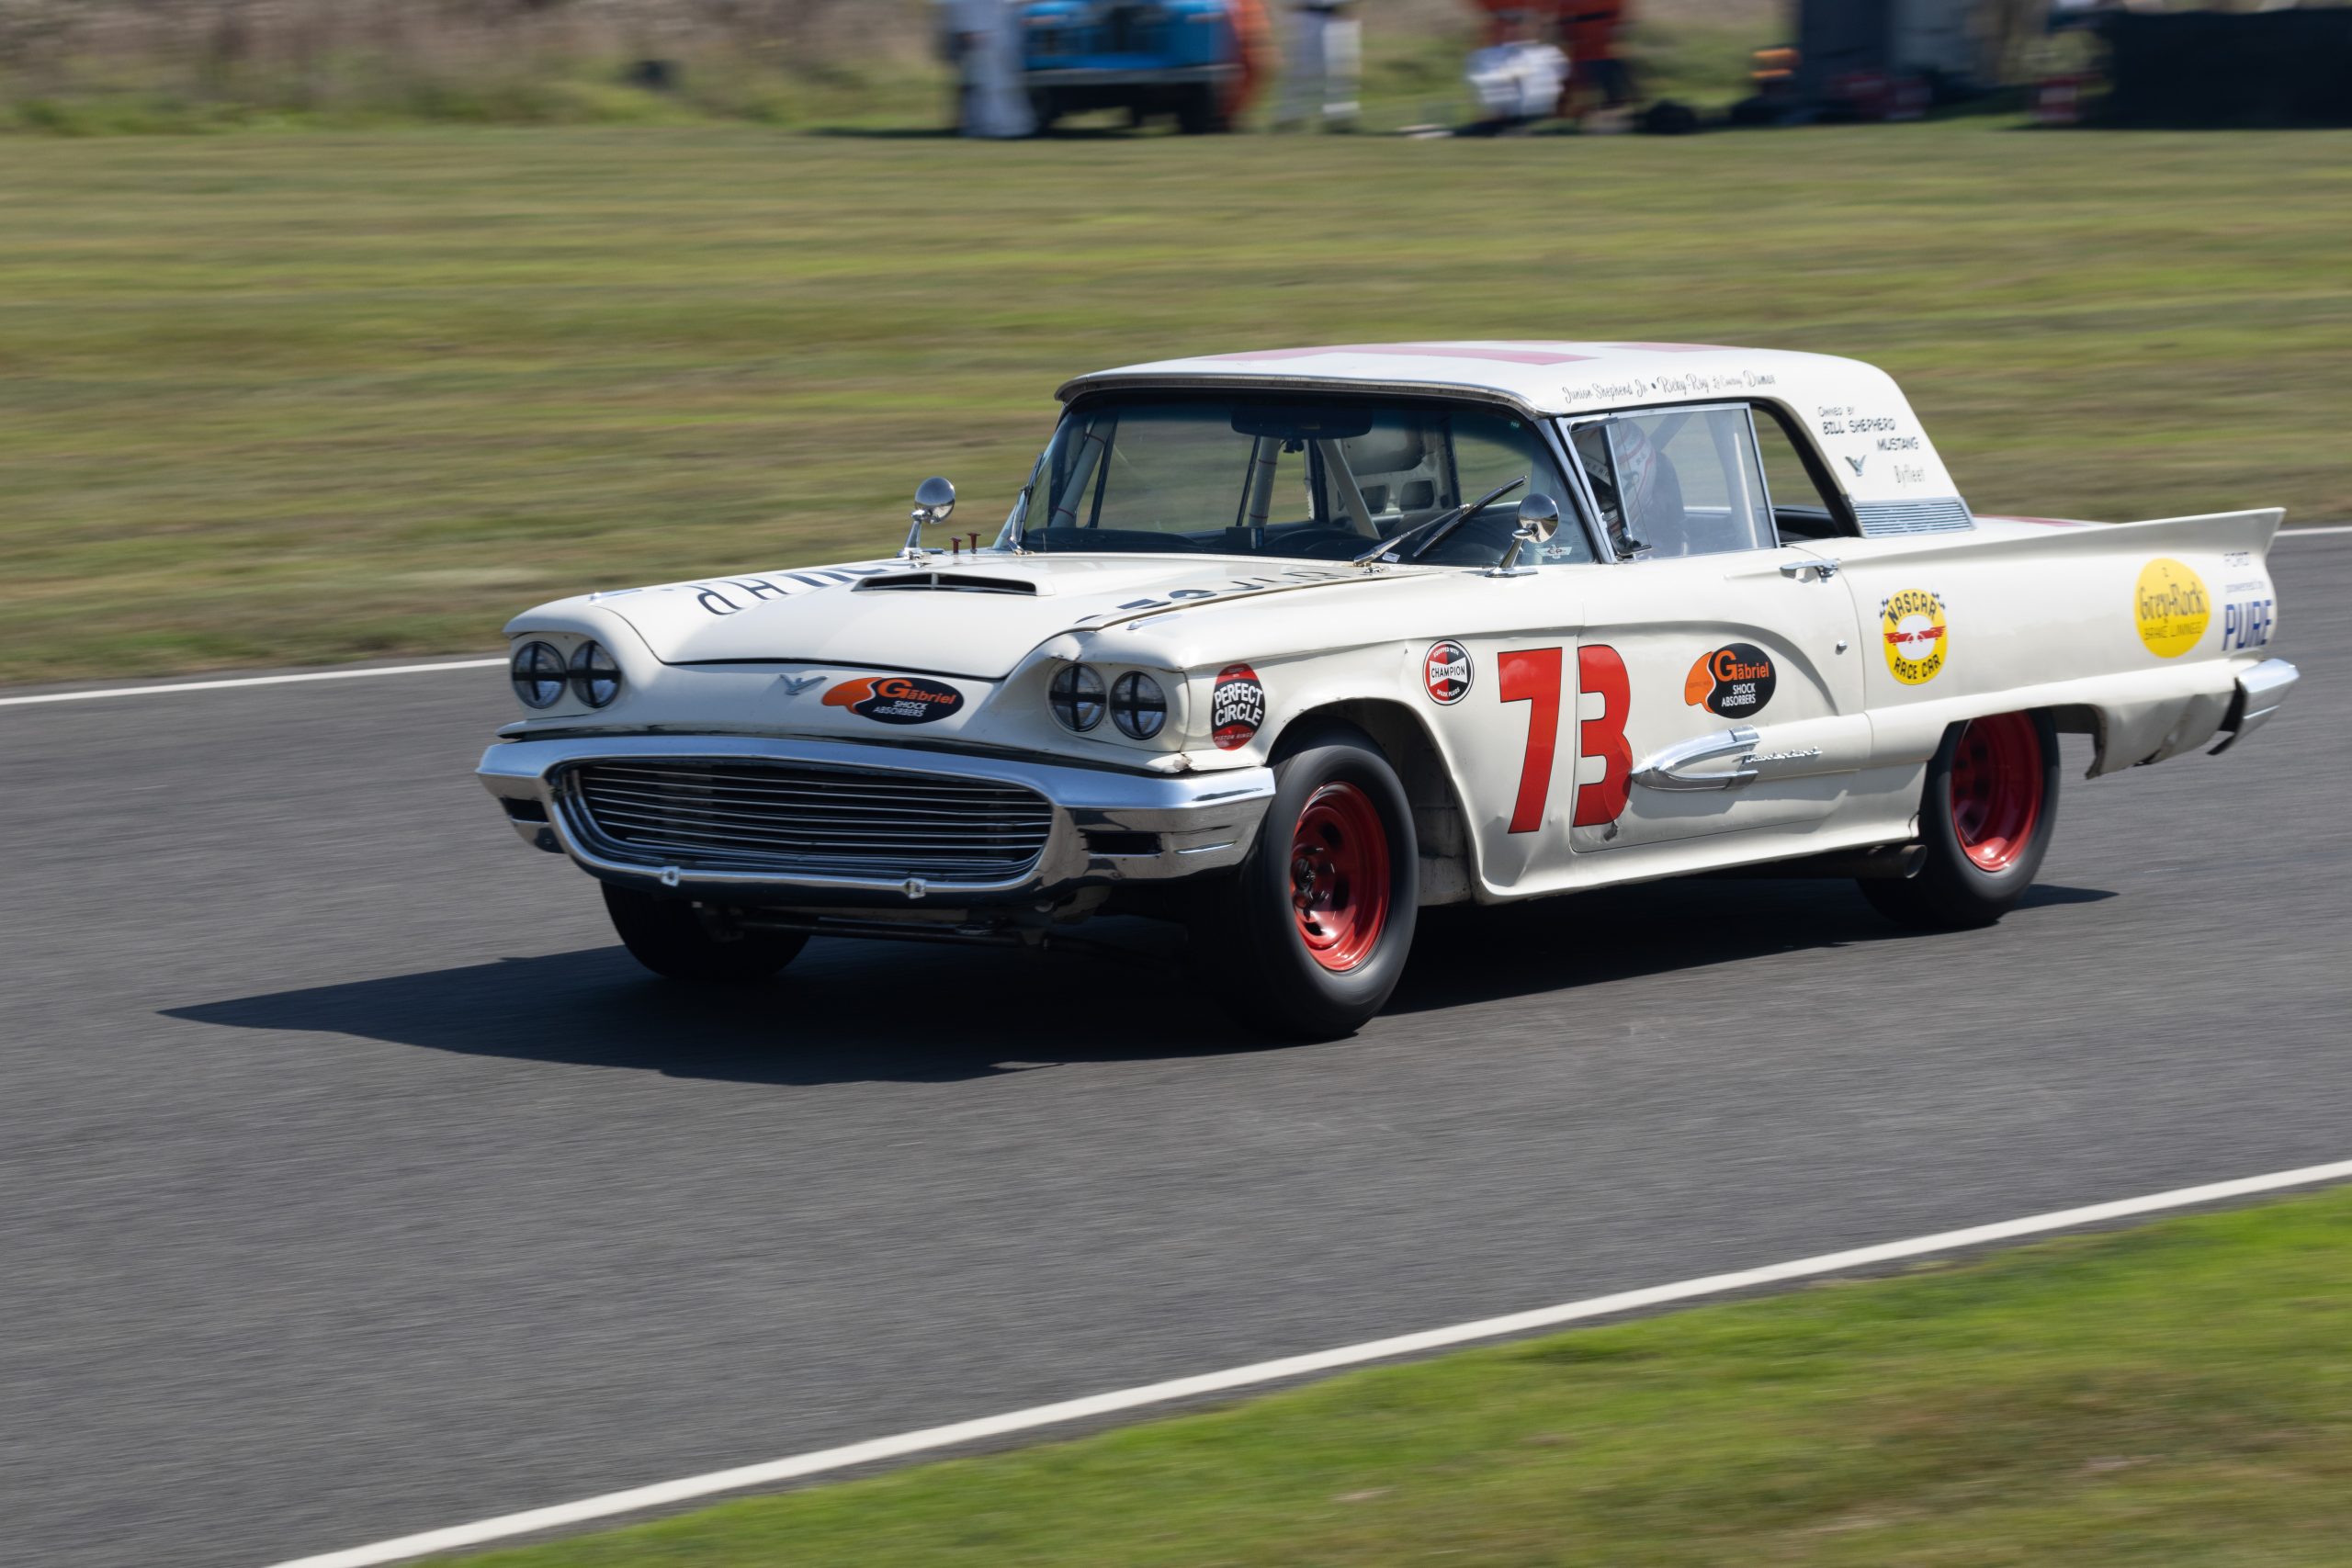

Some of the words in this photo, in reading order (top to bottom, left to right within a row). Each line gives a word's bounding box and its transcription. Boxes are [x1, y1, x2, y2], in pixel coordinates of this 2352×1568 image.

[1876, 436, 1918, 451] MUSTANG
[1887, 592, 1937, 626] NASCAR
[1430, 665, 1465, 679] CHAMPION
[1894, 656, 1917, 680] RACE
[1921, 653, 1941, 678] CAR
[1214, 682, 1263, 709] PERFECT
[1732, 682, 1756, 694] SHOCK
[893, 700, 929, 710] SHOCK
[1721, 694, 1757, 707] ABSORBERS
[873, 706, 925, 717] ABSORBERS
[1215, 703, 1263, 727] CIRCLE
[1497, 644, 1634, 834] 73
